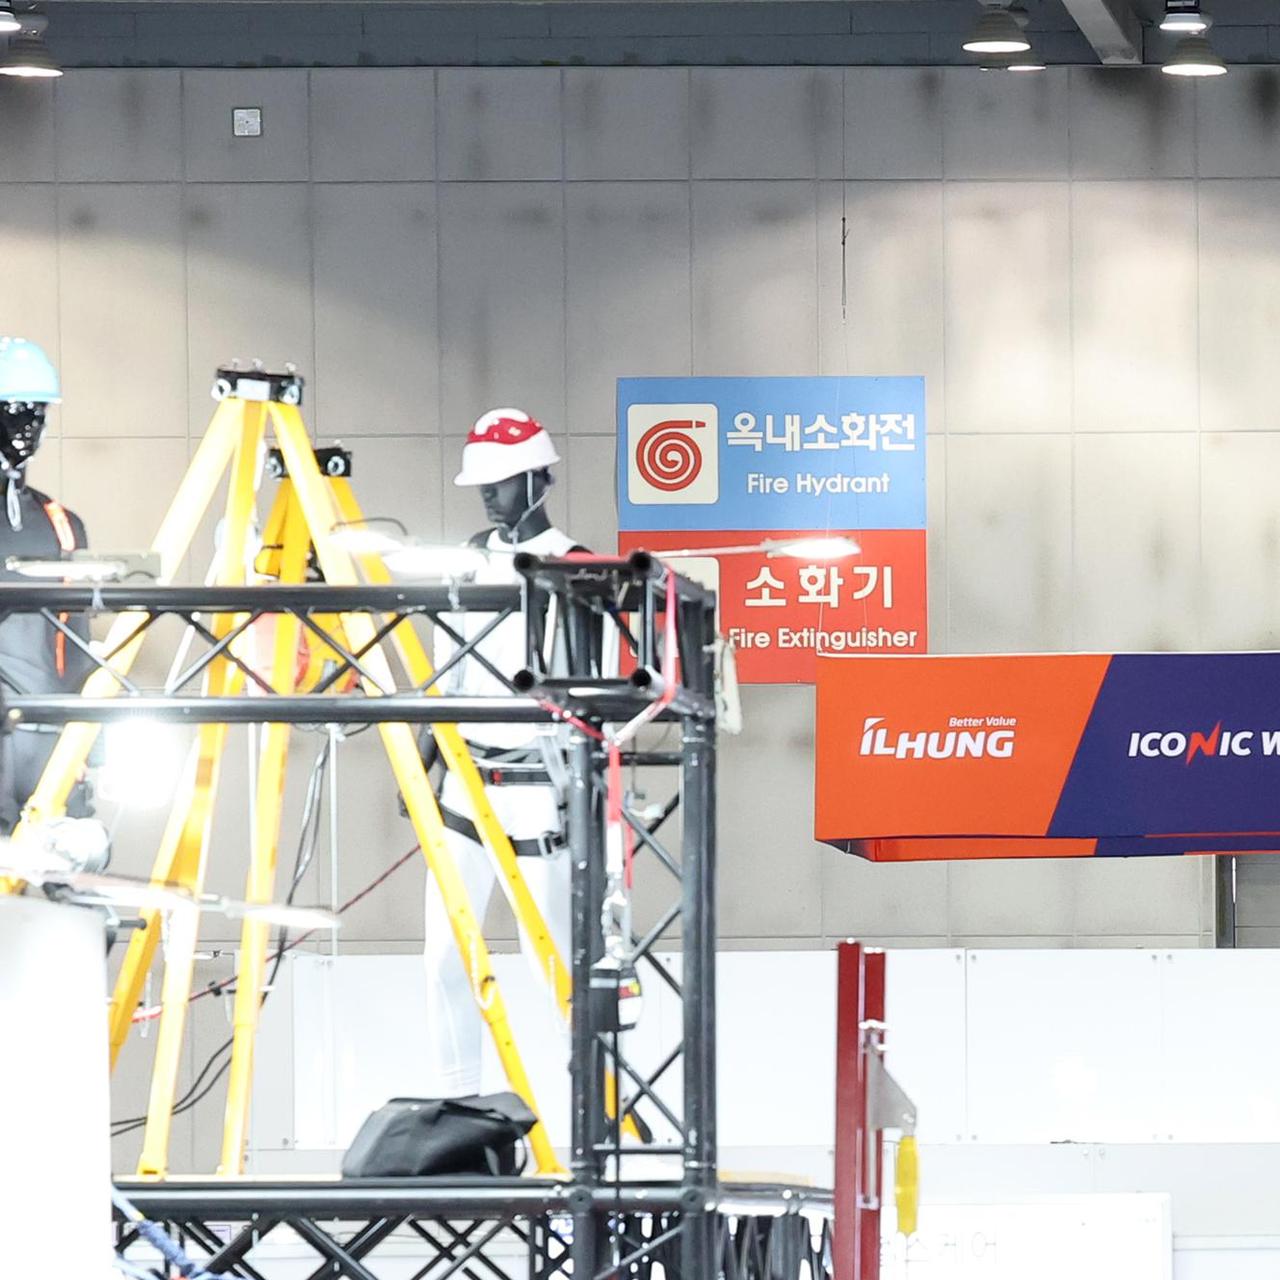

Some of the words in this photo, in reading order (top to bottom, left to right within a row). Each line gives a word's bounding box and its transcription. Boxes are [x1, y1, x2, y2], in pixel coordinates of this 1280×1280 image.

[726, 411, 917, 452] 옥내소화전
[747, 473, 789, 494] Fire
[796, 473, 890, 497] Hydrant
[728, 627, 771, 649] Fire
[777, 627, 918, 650] Extinguisher
[949, 716, 989, 728] Better
[992, 716, 1017, 727] Value
[1128, 719, 1253, 766] ICONIC
